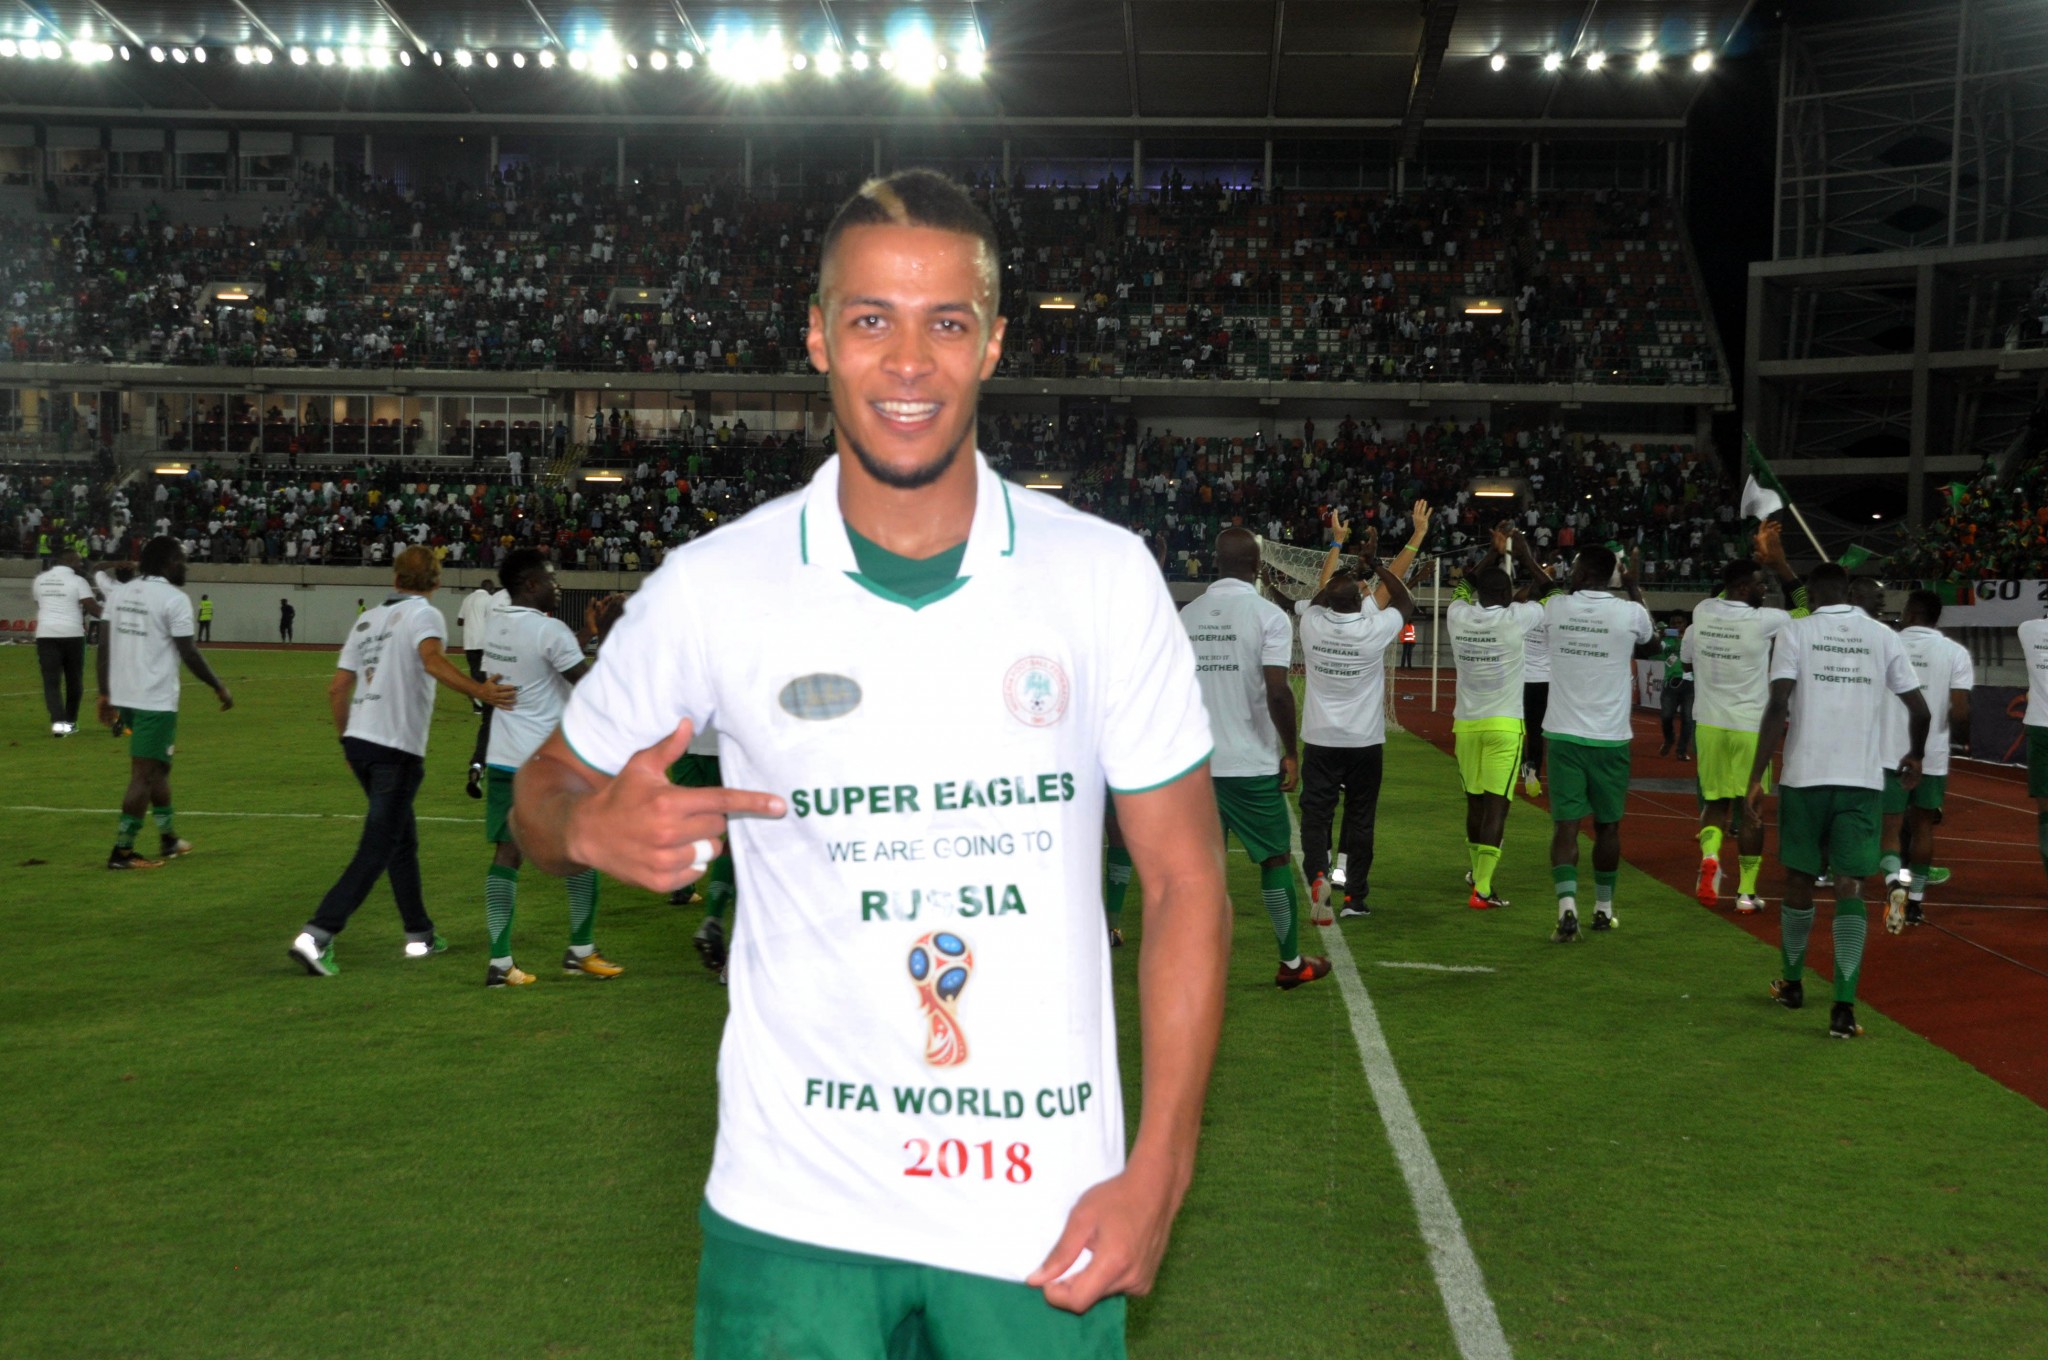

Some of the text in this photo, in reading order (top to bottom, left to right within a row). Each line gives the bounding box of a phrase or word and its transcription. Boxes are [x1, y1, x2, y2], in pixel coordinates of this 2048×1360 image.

[1976, 579, 2021, 601] GO
[1559, 624, 1609, 634] NIGERIANS
[1700, 630, 1740, 640] NIGERIANS
[1455, 635, 1497, 643] NIGERIANS
[1312, 645, 1359, 657] NIGERIANS
[1559, 647, 1609, 658] TOGETHER!
[1812, 644, 1871, 655] NIGERIANS
[1458, 654, 1500, 663] TOGETHER!
[1195, 664, 1240, 672] OGETHER
[1314, 665, 1361, 677] TOGETHER!
[1812, 673, 1872, 685] TOGETHER!
[791, 772, 1076, 818] SUPER EAGLES
[826, 829, 1053, 862] WE ARE GOING TO
[804, 1077, 1093, 1119] FIFA WORLD CUP
[902, 1137, 1034, 1185] 2018
